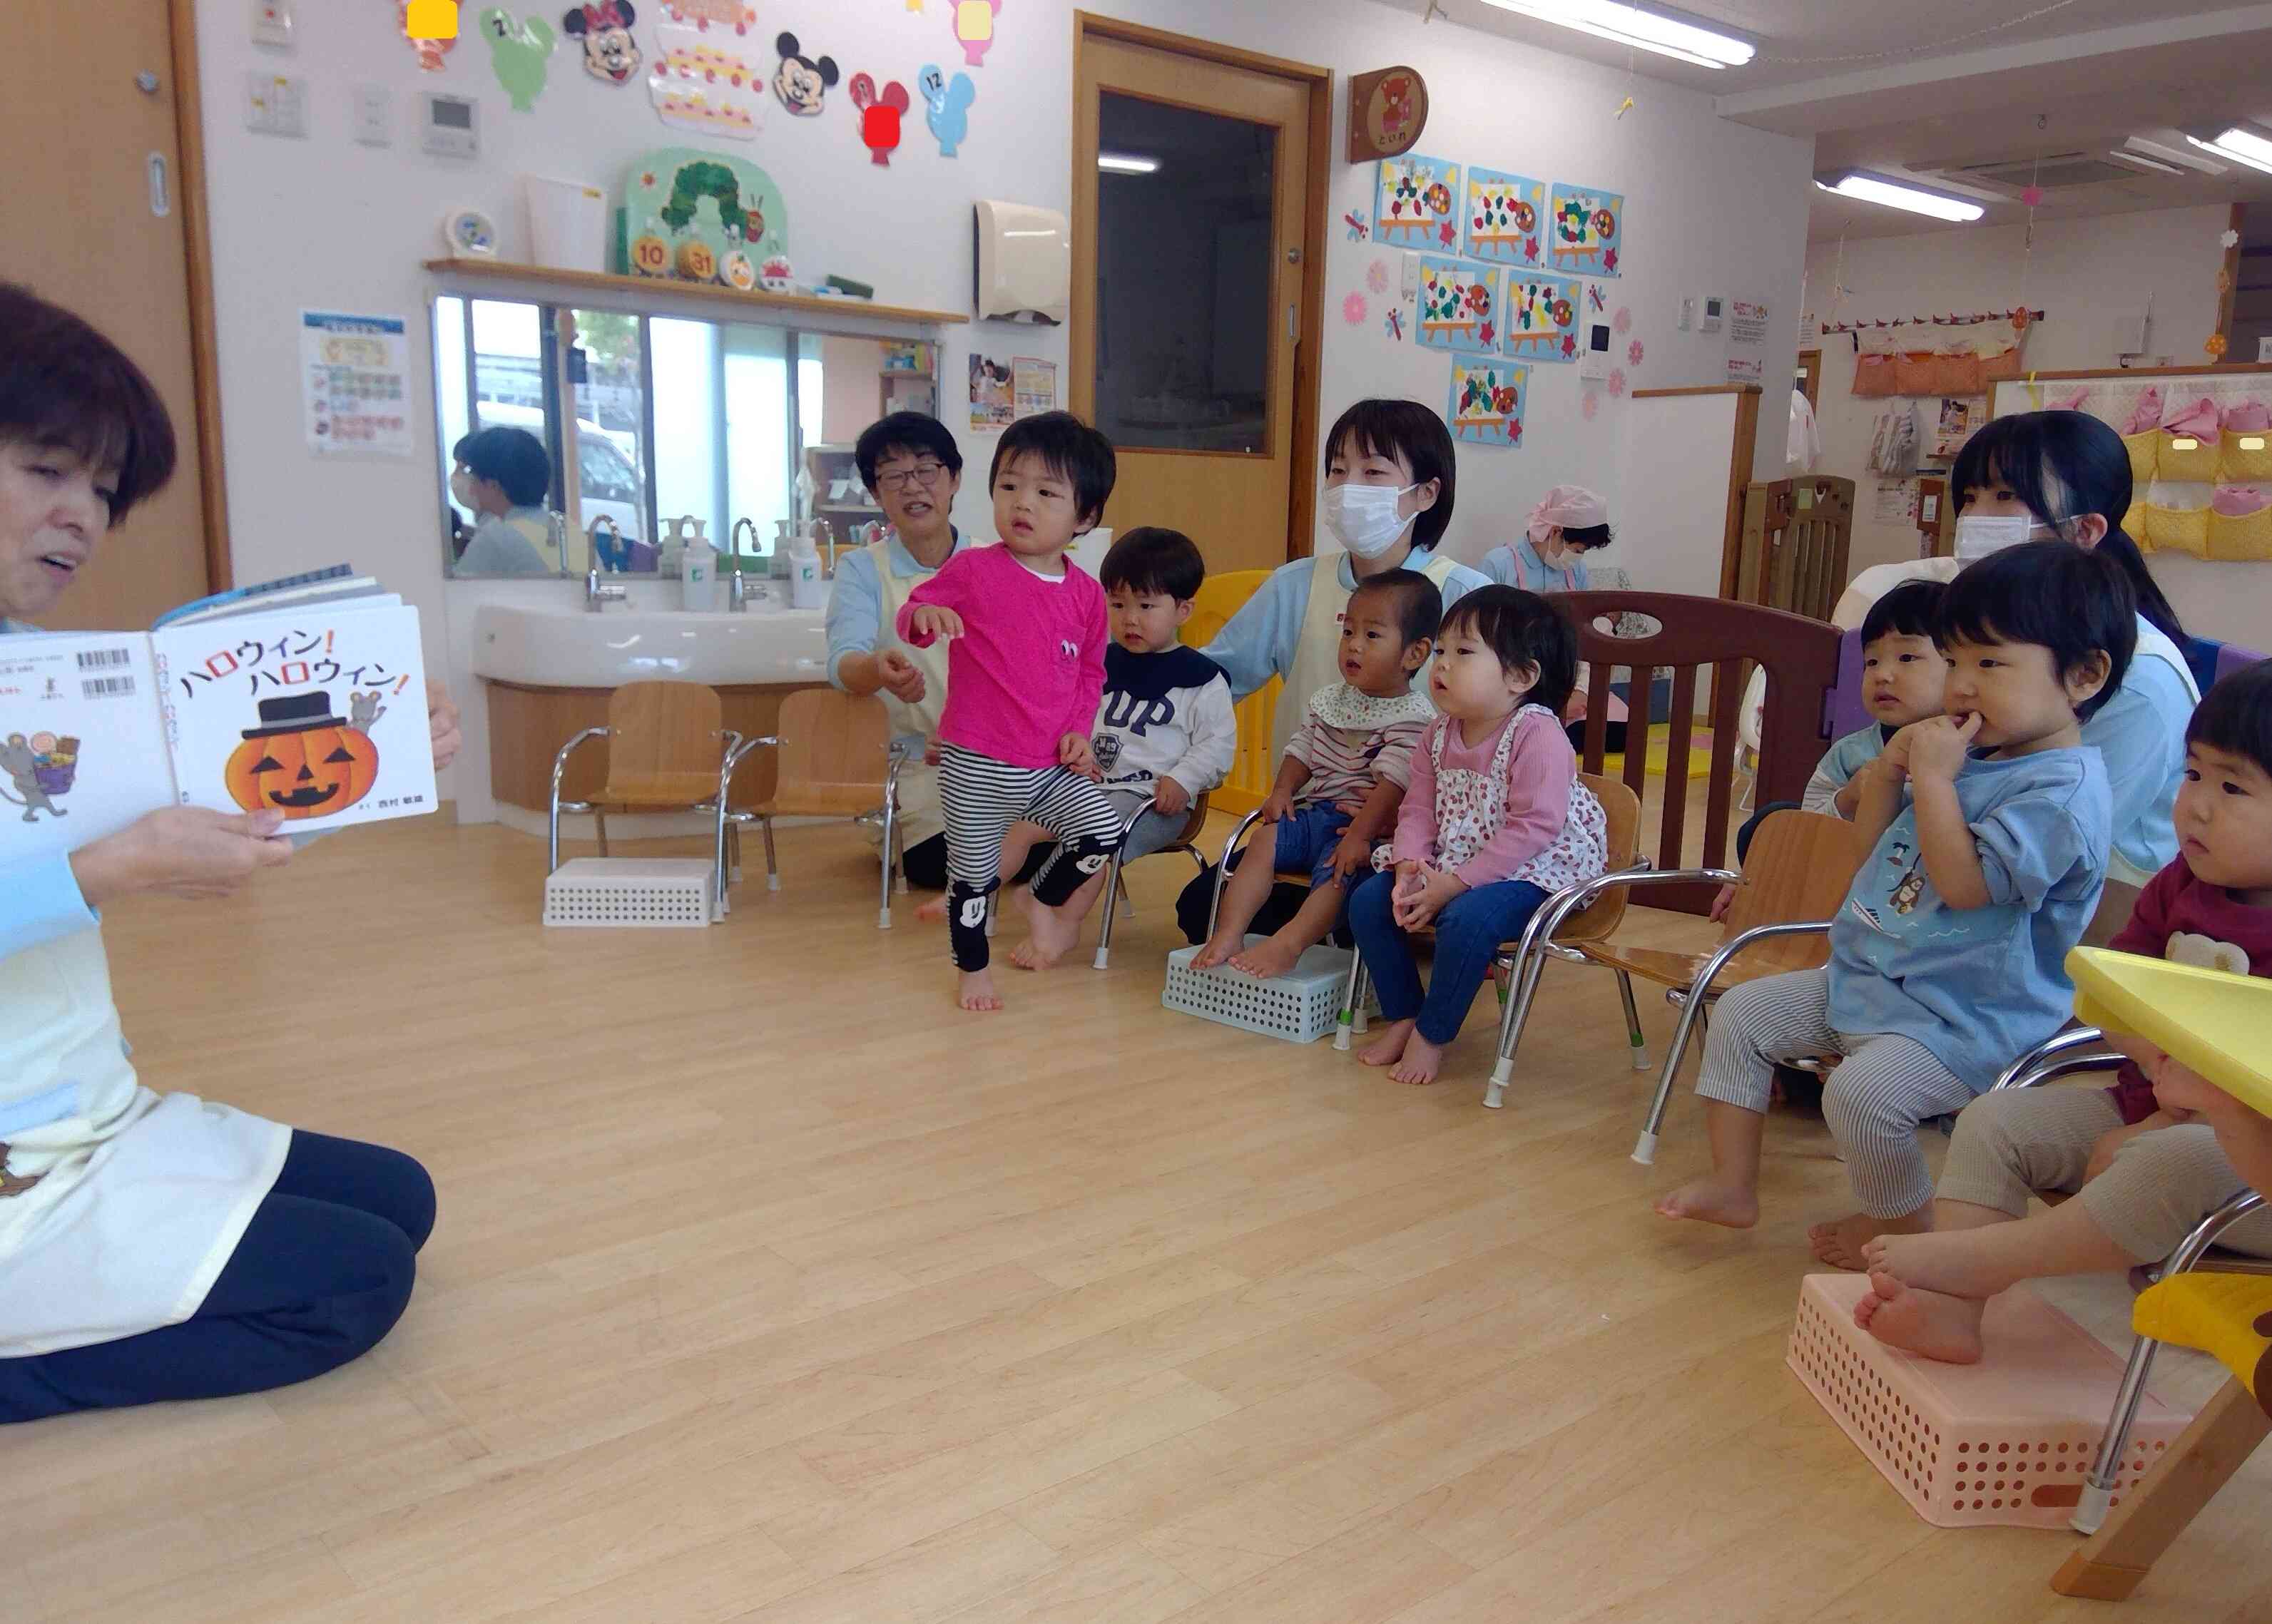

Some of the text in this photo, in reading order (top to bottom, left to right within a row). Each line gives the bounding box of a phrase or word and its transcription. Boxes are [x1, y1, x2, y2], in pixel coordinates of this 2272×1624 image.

[927, 73, 942, 91] 12
[638, 244, 663, 265] 10
[688, 250, 711, 275] 31
[180, 629, 334, 698] ハロウィン!
[250, 658, 410, 696] ハロウィン!
